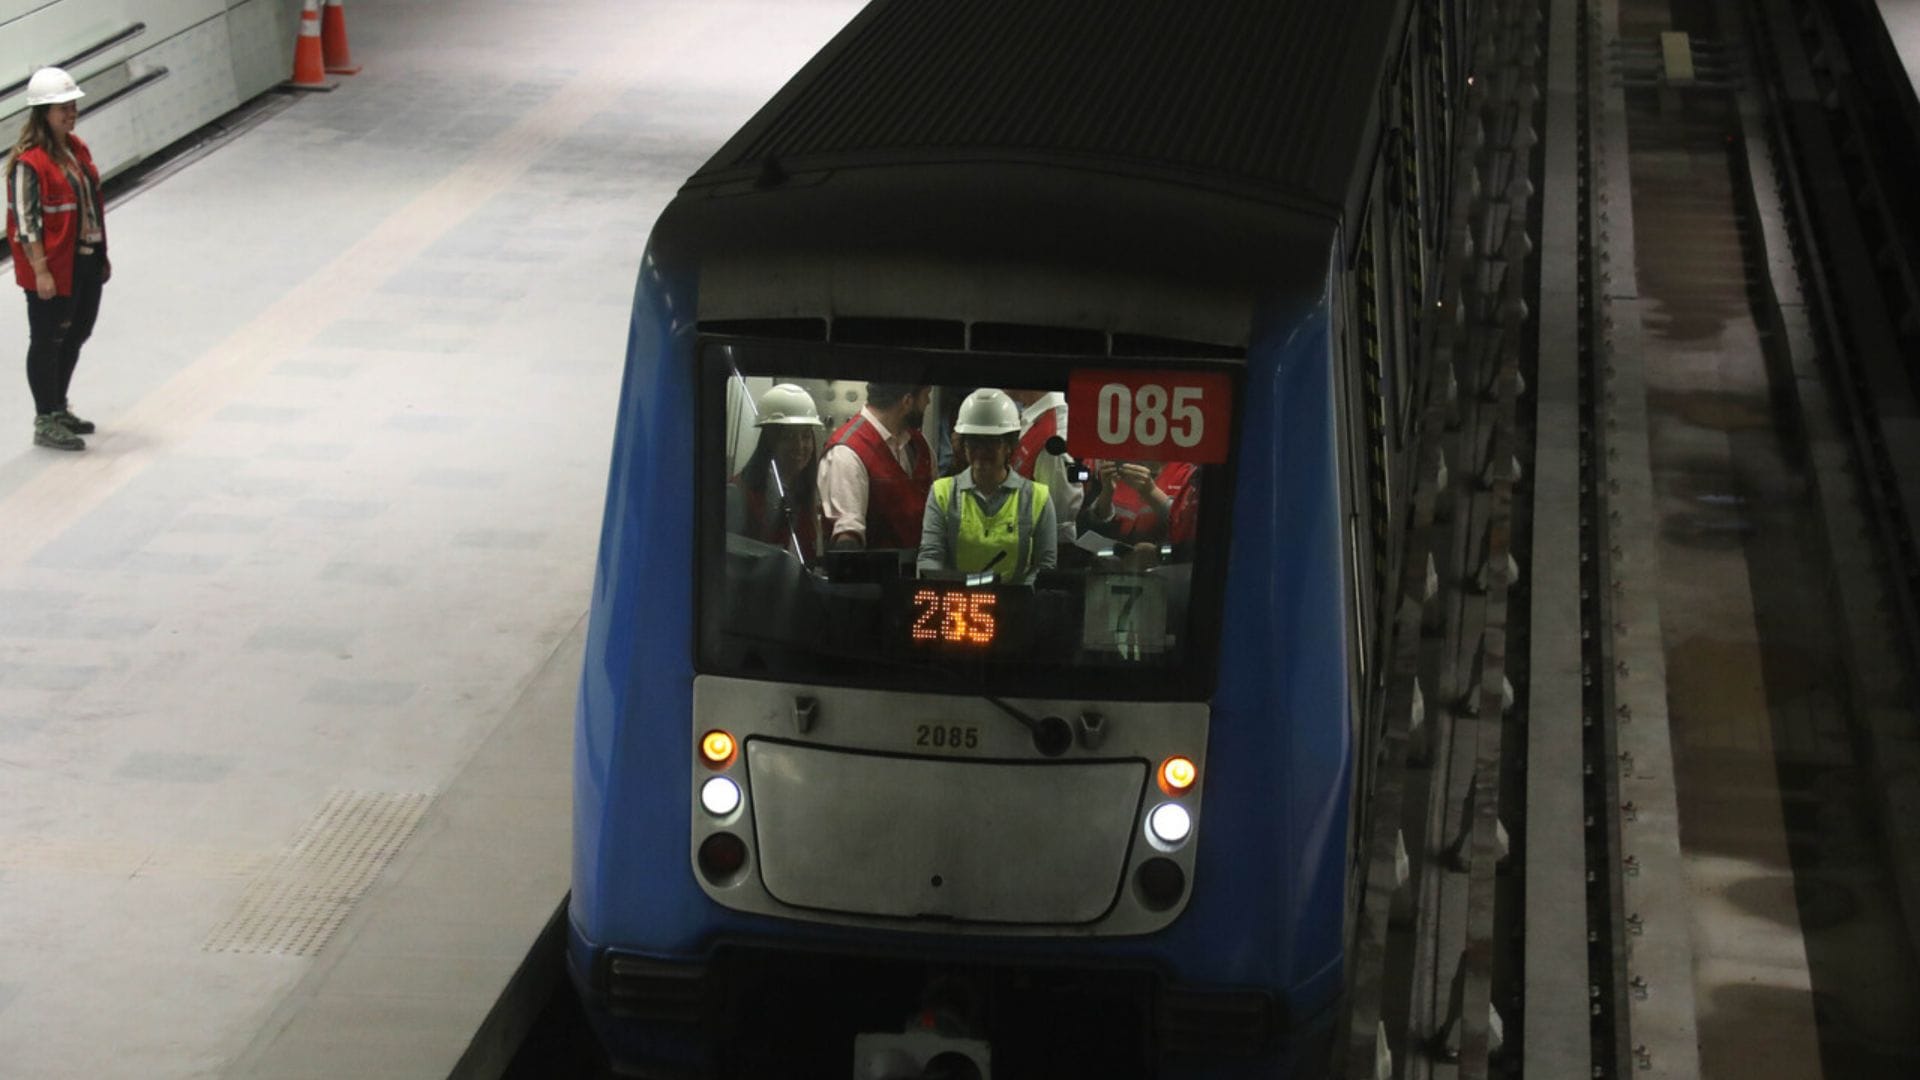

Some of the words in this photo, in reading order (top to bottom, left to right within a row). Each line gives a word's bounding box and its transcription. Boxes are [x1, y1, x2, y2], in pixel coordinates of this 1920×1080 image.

[1097, 382, 1204, 448] 085
[912, 590, 996, 642] 285
[1110, 585, 1143, 633] 7
[916, 724, 978, 749] 2085
